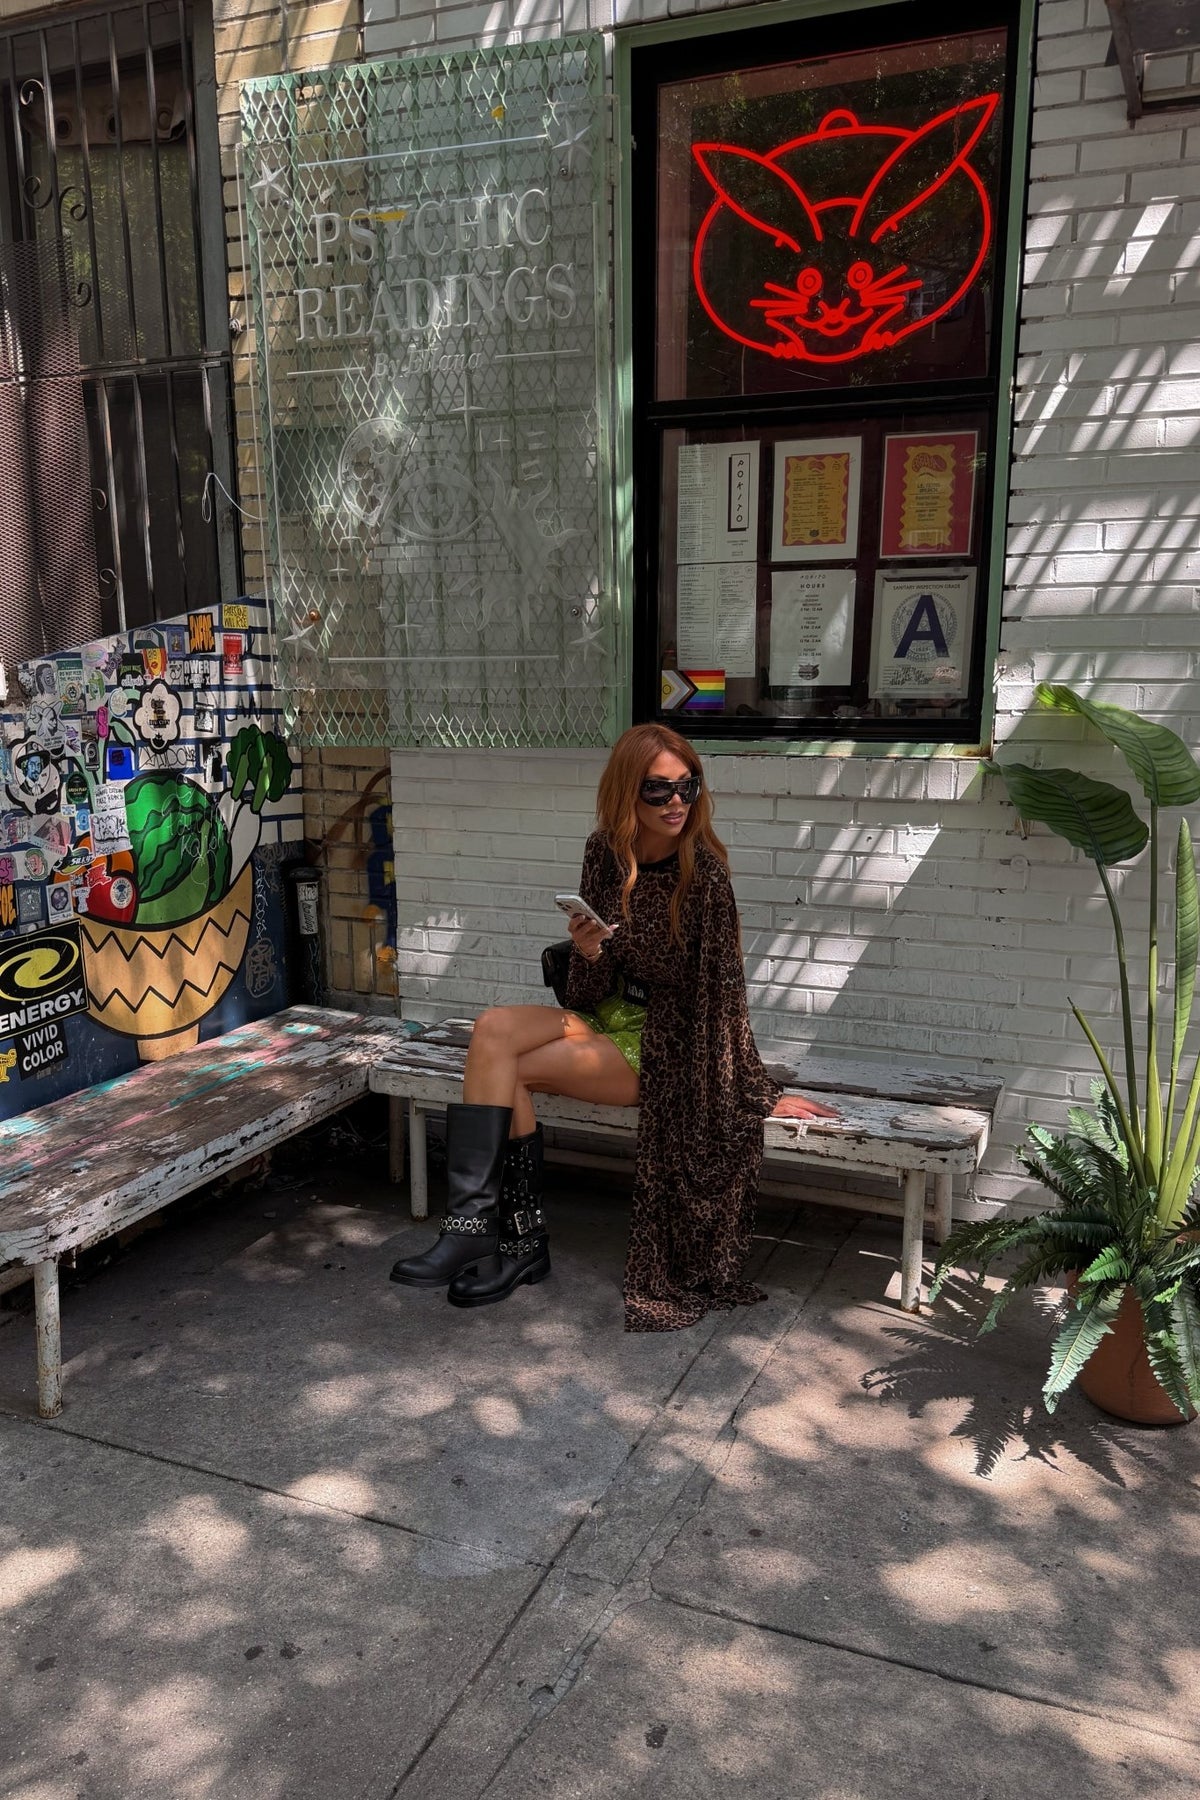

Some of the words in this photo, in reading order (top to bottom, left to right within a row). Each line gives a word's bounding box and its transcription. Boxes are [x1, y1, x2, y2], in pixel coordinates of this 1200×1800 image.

[310, 187, 551, 269] PSYCHIC
[293, 262, 577, 343] READINGS
[374, 352, 401, 382] By
[736, 460, 745, 523] POKITO
[893, 594, 950, 659] A
[0, 987, 84, 1034] ENERGY
[22, 1024, 58, 1051] VIVID
[22, 1040, 64, 1072] COLOR
